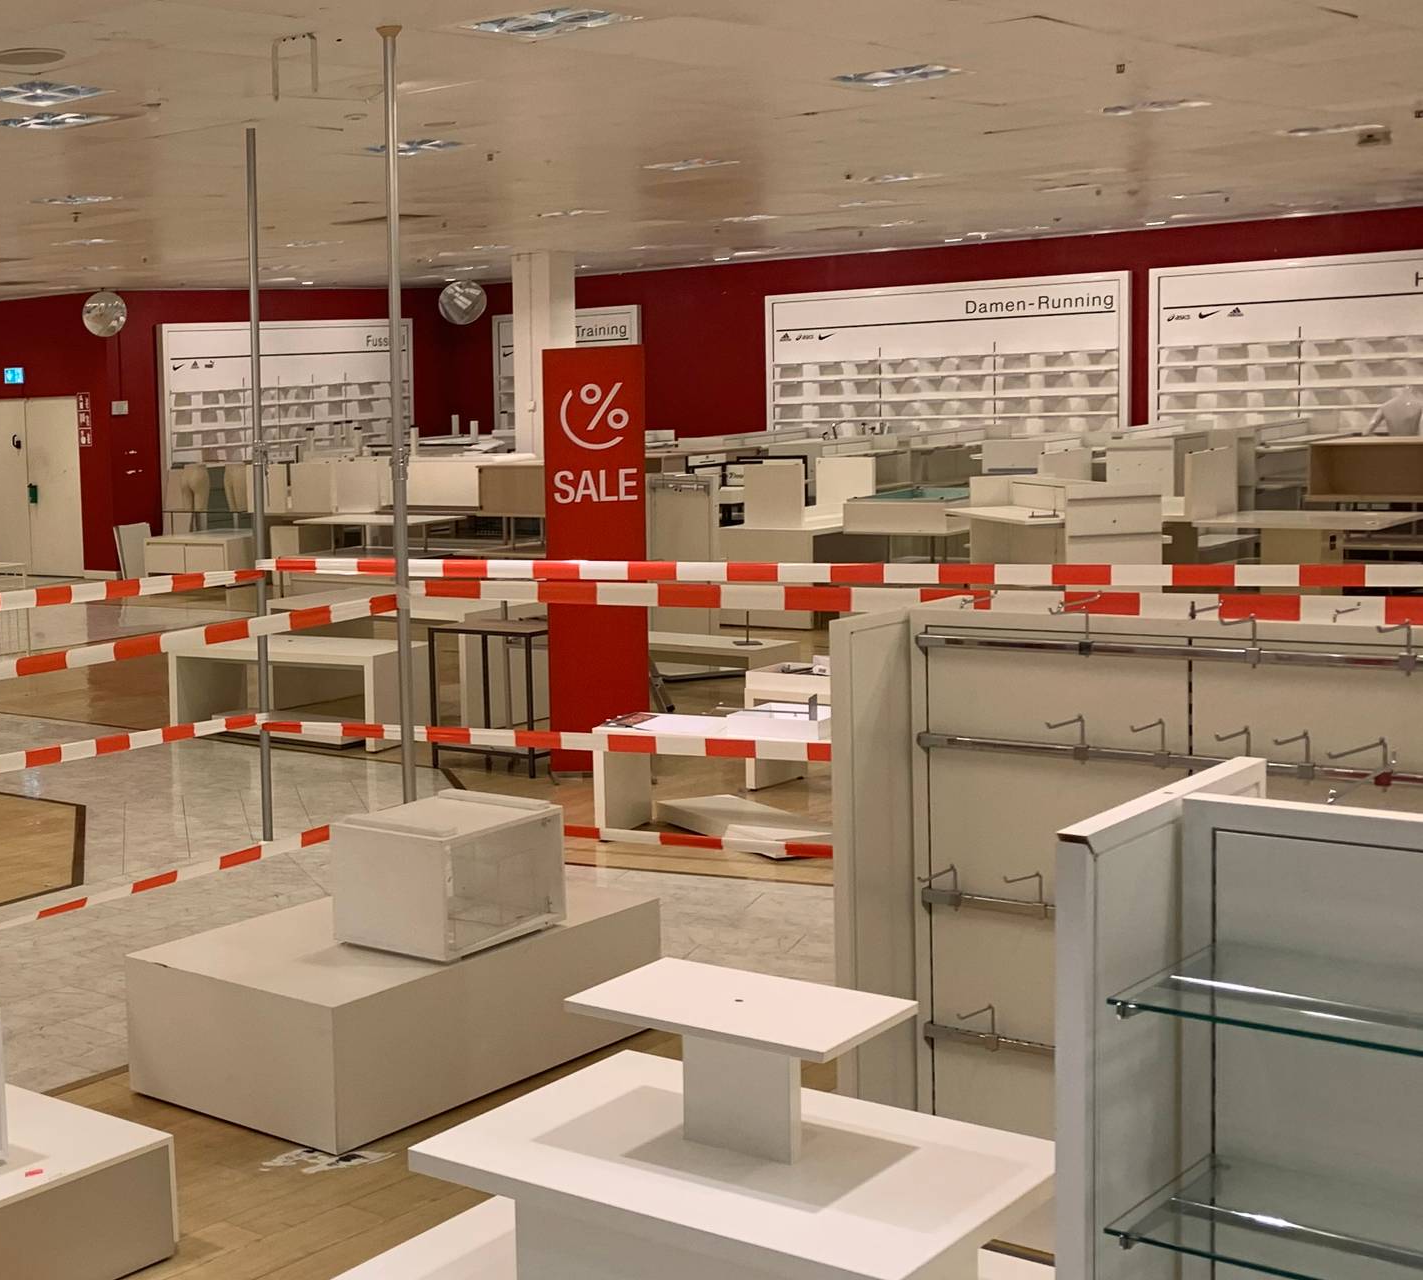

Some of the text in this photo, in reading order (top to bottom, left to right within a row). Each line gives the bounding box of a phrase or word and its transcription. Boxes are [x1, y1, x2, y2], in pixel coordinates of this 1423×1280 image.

[965, 293, 1114, 314] Damen-Running
[575, 324, 627, 338] Training
[366, 334, 406, 347] Fussl
[553, 467, 639, 504] SALE
